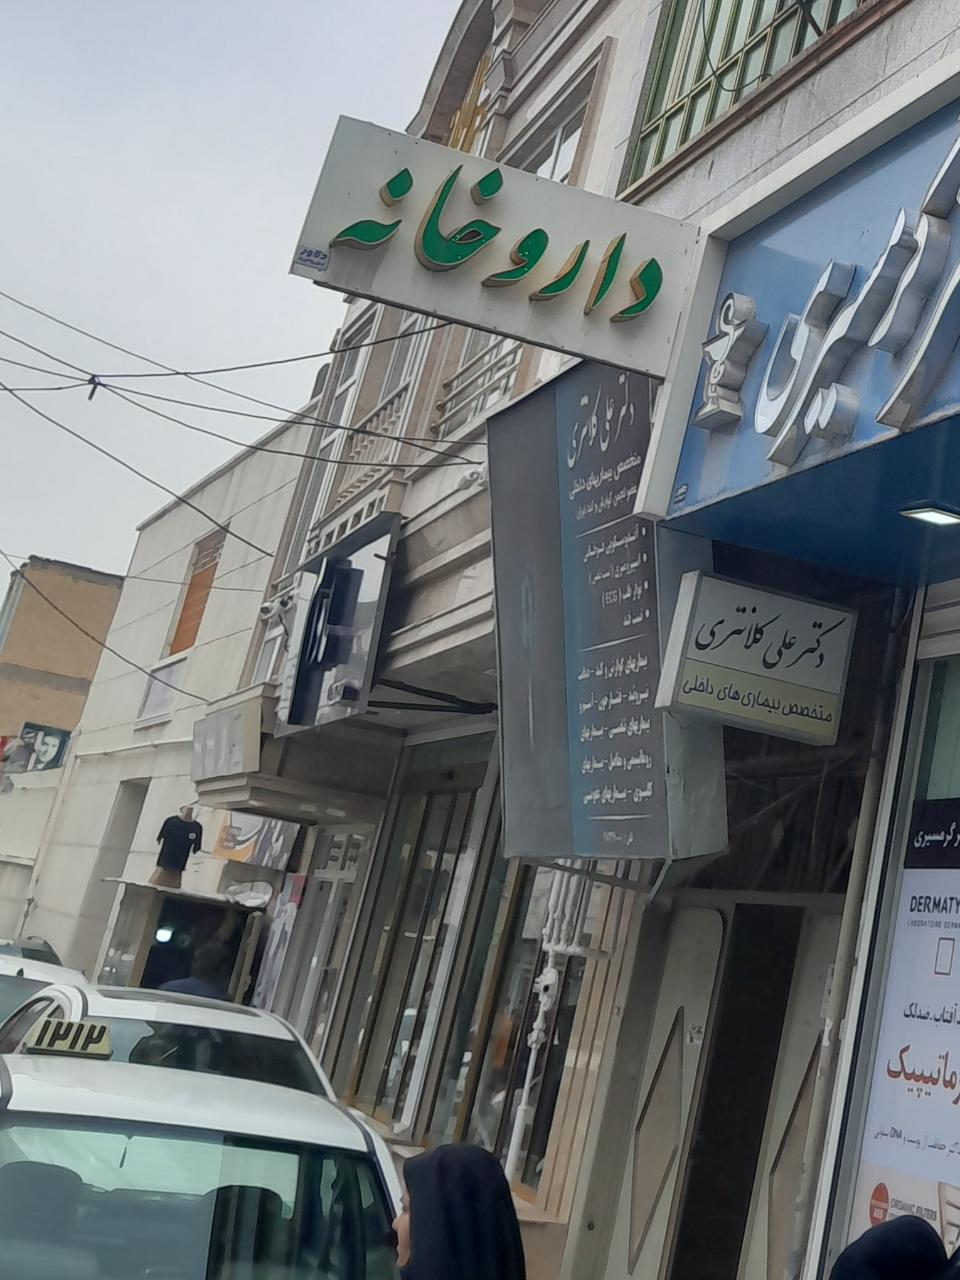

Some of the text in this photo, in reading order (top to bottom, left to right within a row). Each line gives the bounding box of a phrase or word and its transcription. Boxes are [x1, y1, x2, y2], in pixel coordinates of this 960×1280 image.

[329, 164, 664, 323] داروخانه
[614, 371, 635, 441] دکتر
[600, 396, 614, 452] علی
[614, 452, 642, 481] متخصص
[694, 605, 846, 669] دکتر علی کلانتری
[682, 674, 714, 695] داخلی
[782, 704, 833, 723] متخصص
[914, 822, 956, 847] گرمسیری
[35, 1020, 107, 1051] ۱۲۱۲
[916, 1205, 937, 1222] FILTERS
